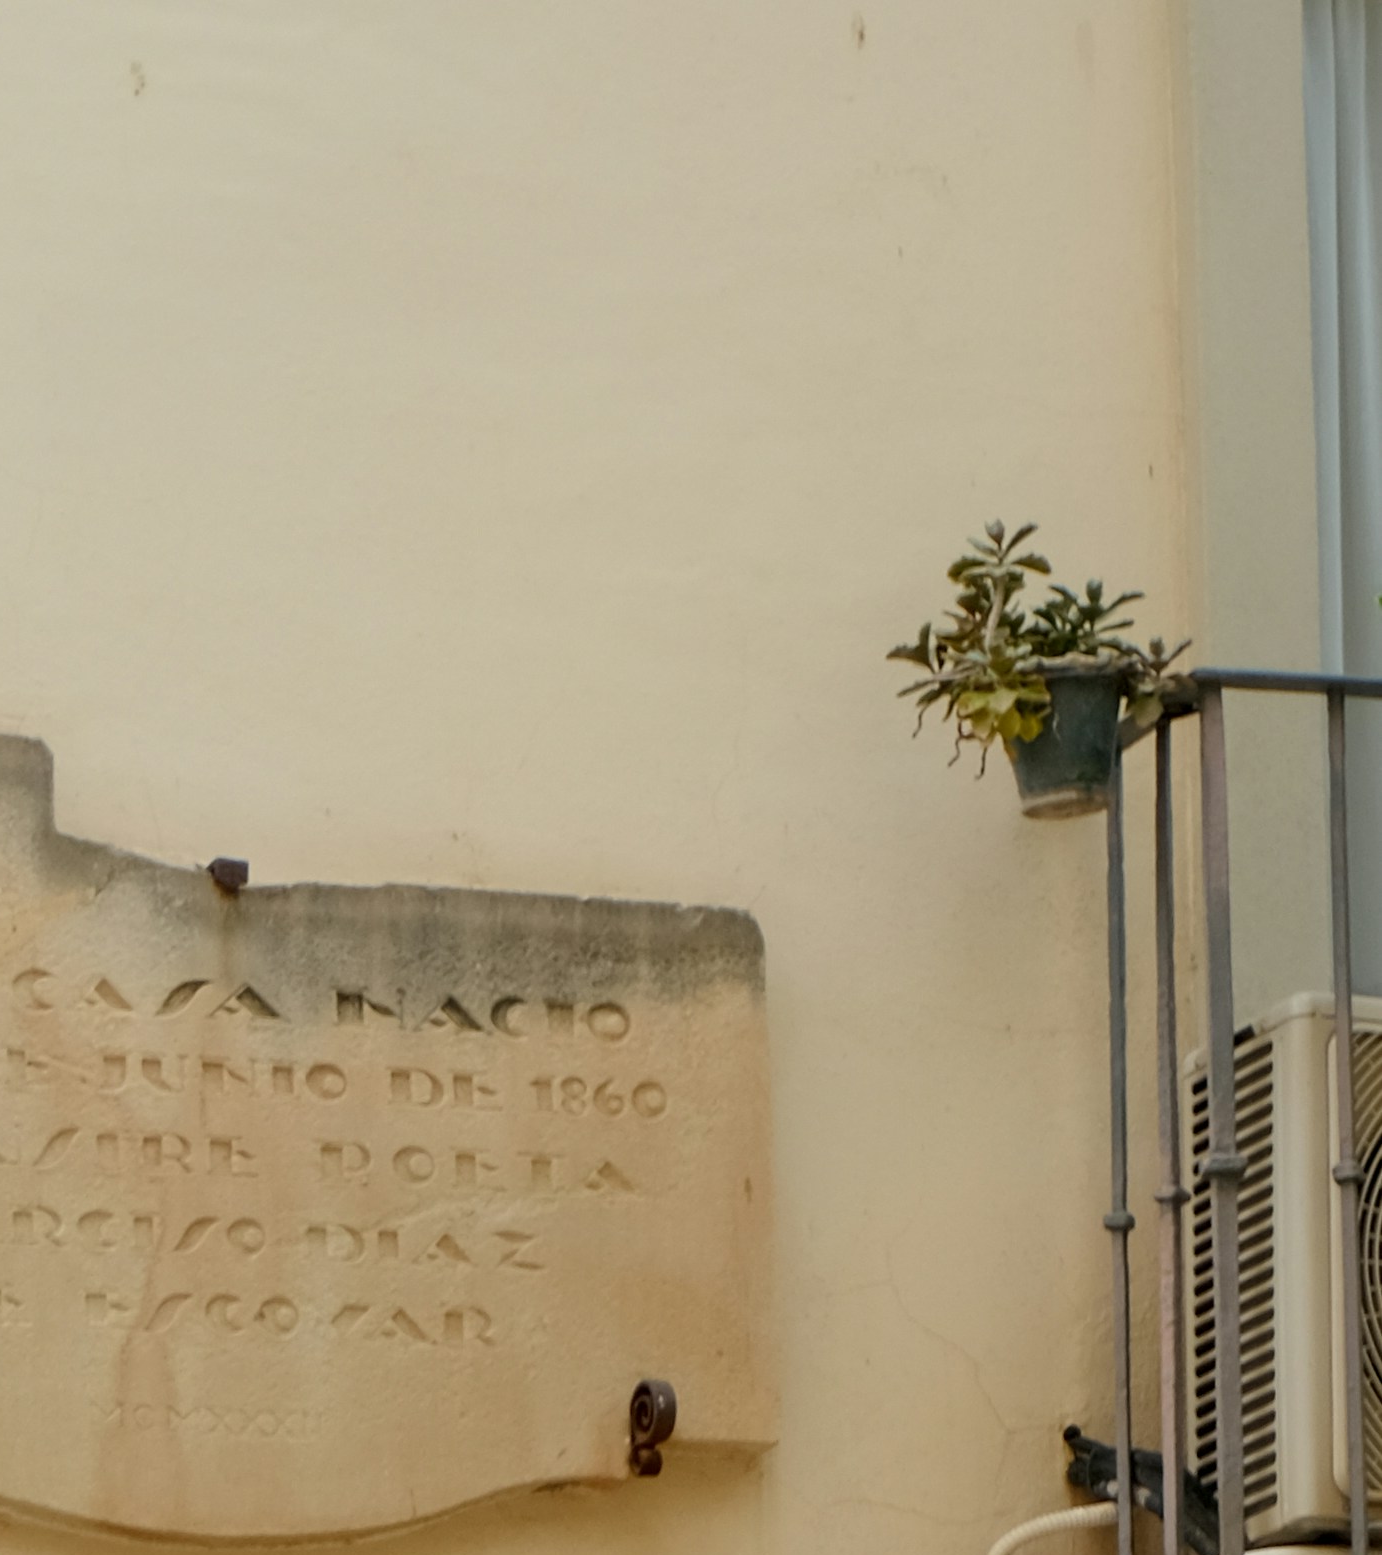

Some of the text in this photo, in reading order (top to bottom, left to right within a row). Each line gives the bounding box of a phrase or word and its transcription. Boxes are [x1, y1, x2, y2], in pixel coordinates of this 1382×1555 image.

[10, 965, 285, 1022] CASA
[335, 987, 632, 1042] NACIO
[99, 1052, 348, 1102] JUNIO
[387, 1066, 503, 1111] DE
[530, 1075, 669, 1119] 1860
[317, 1140, 636, 1194] POETA
[301, 1222, 546, 1271] DIAZ
